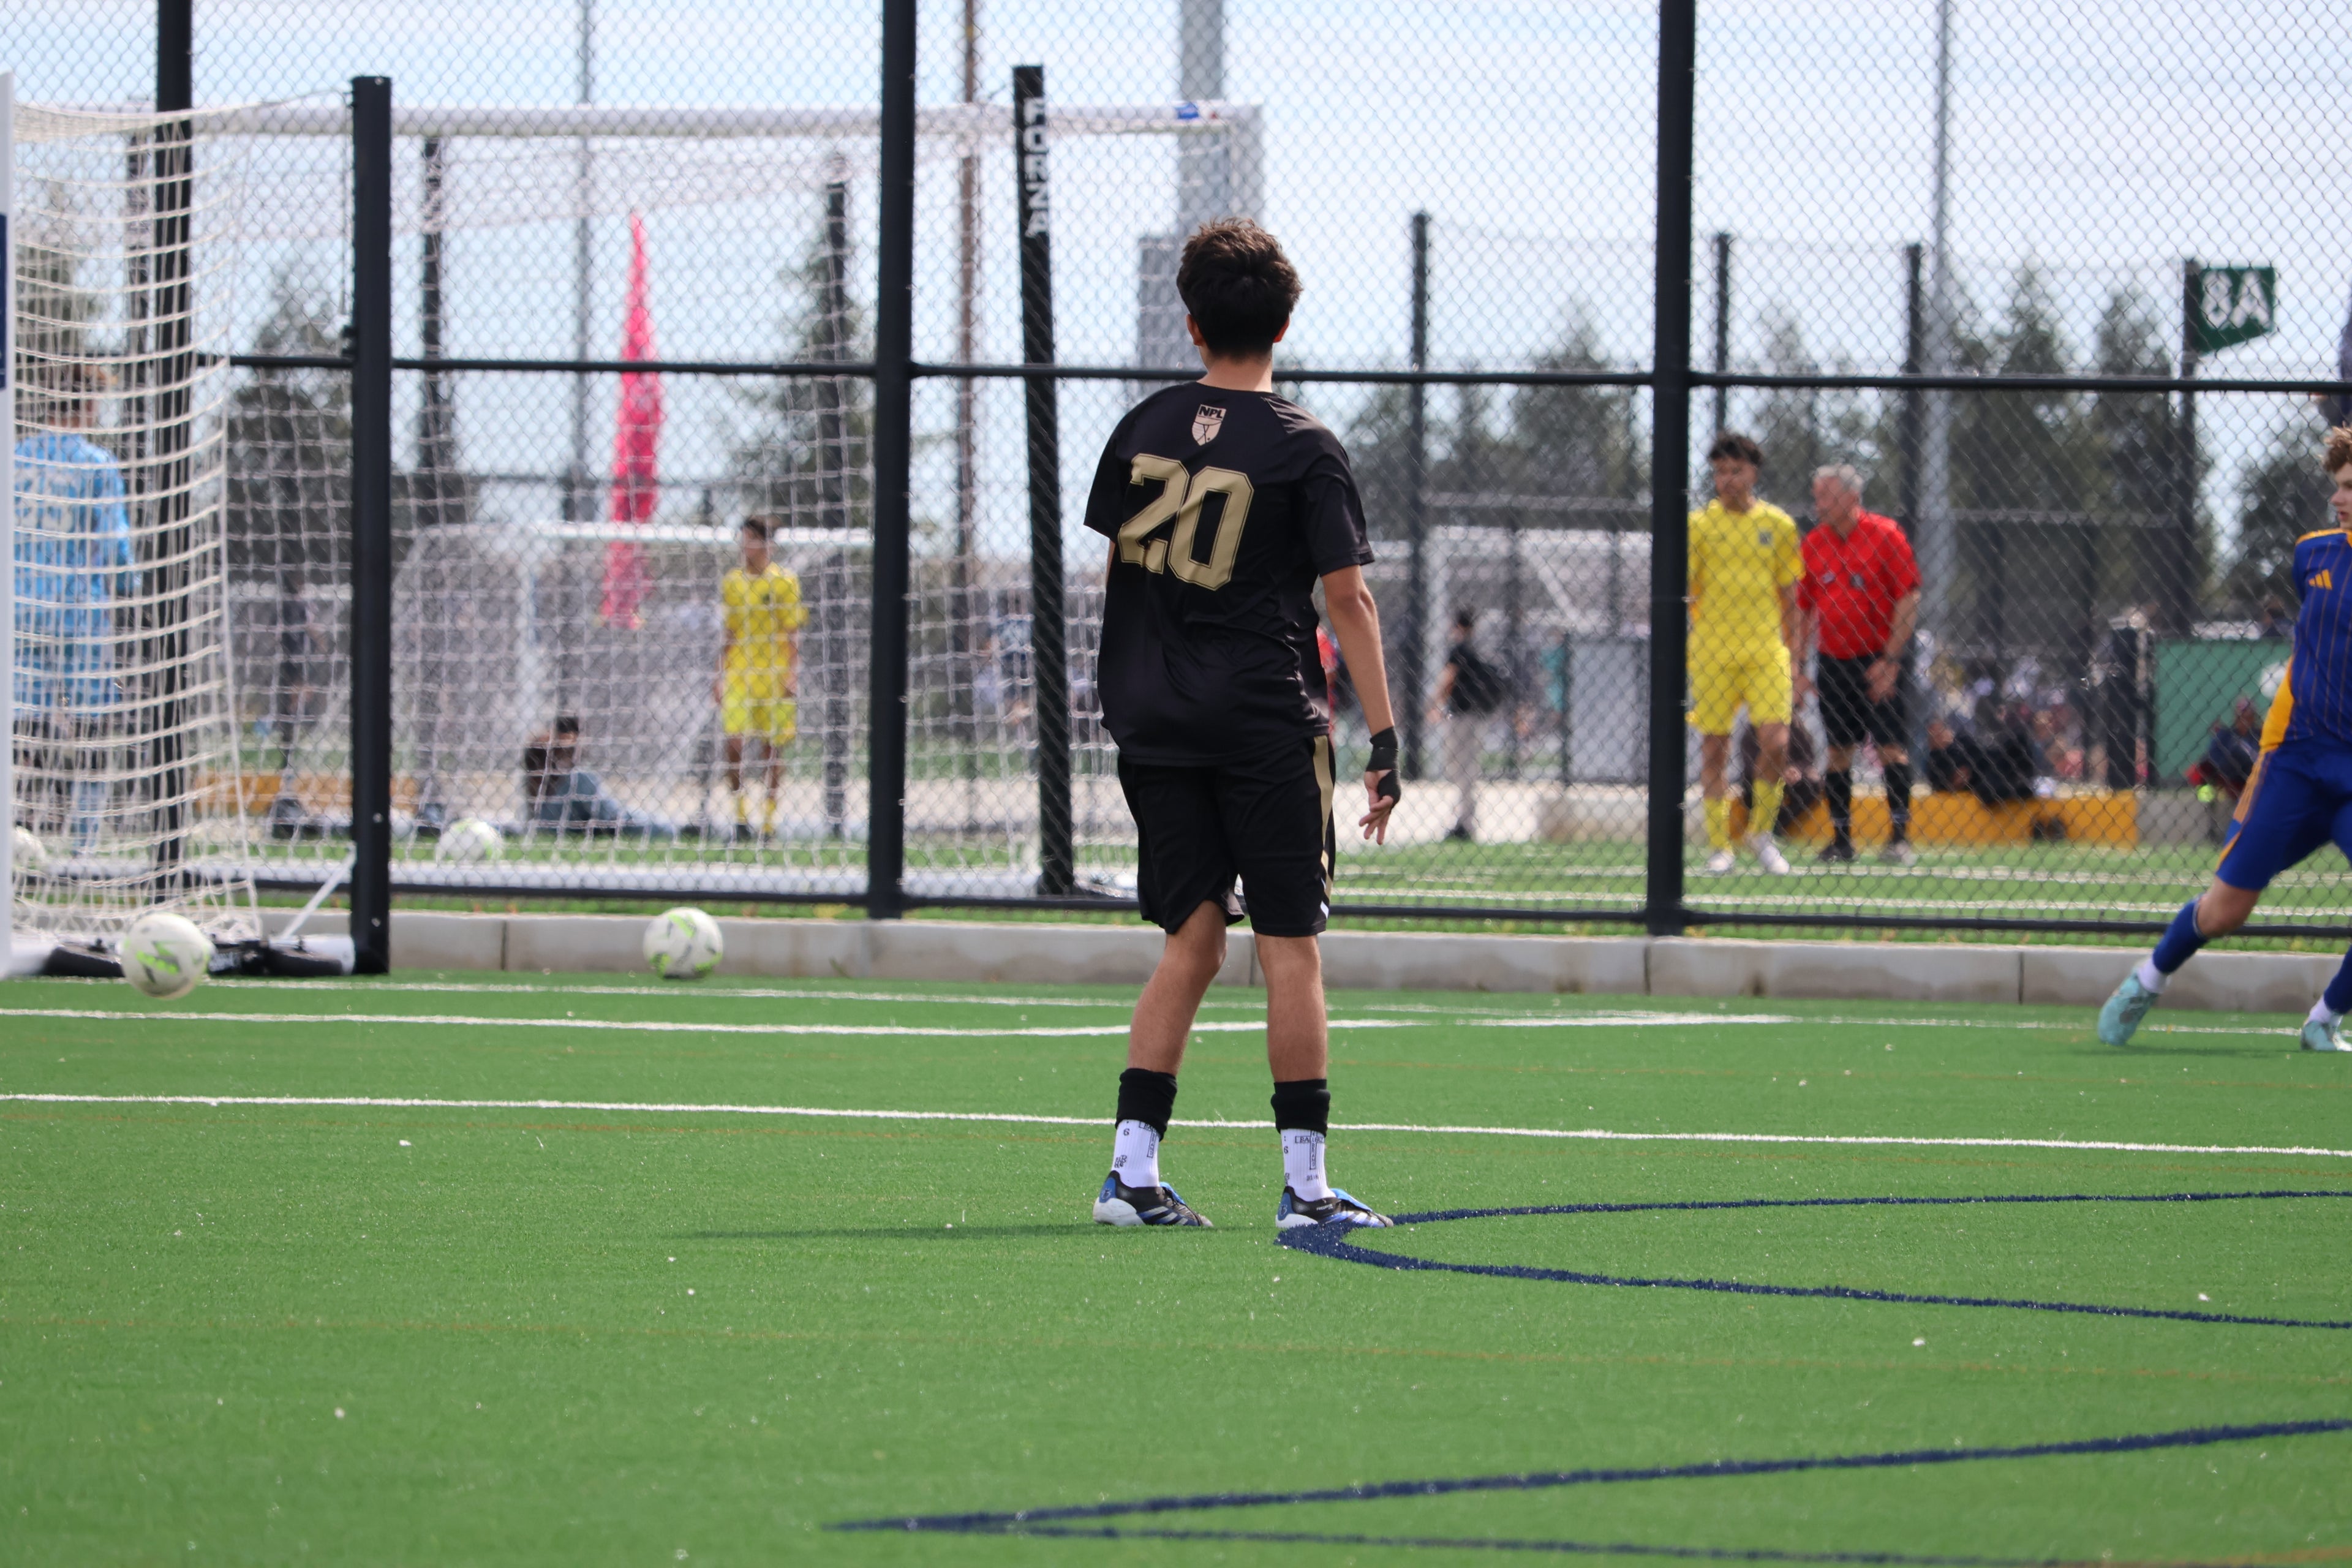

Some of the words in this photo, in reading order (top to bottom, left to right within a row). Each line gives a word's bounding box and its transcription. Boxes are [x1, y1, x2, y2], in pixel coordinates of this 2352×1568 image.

[1023, 97, 1049, 238] FORZA
[2201, 270, 2271, 330] 8A
[1199, 405, 1223, 419] NPL
[1118, 453, 1254, 592] 20
